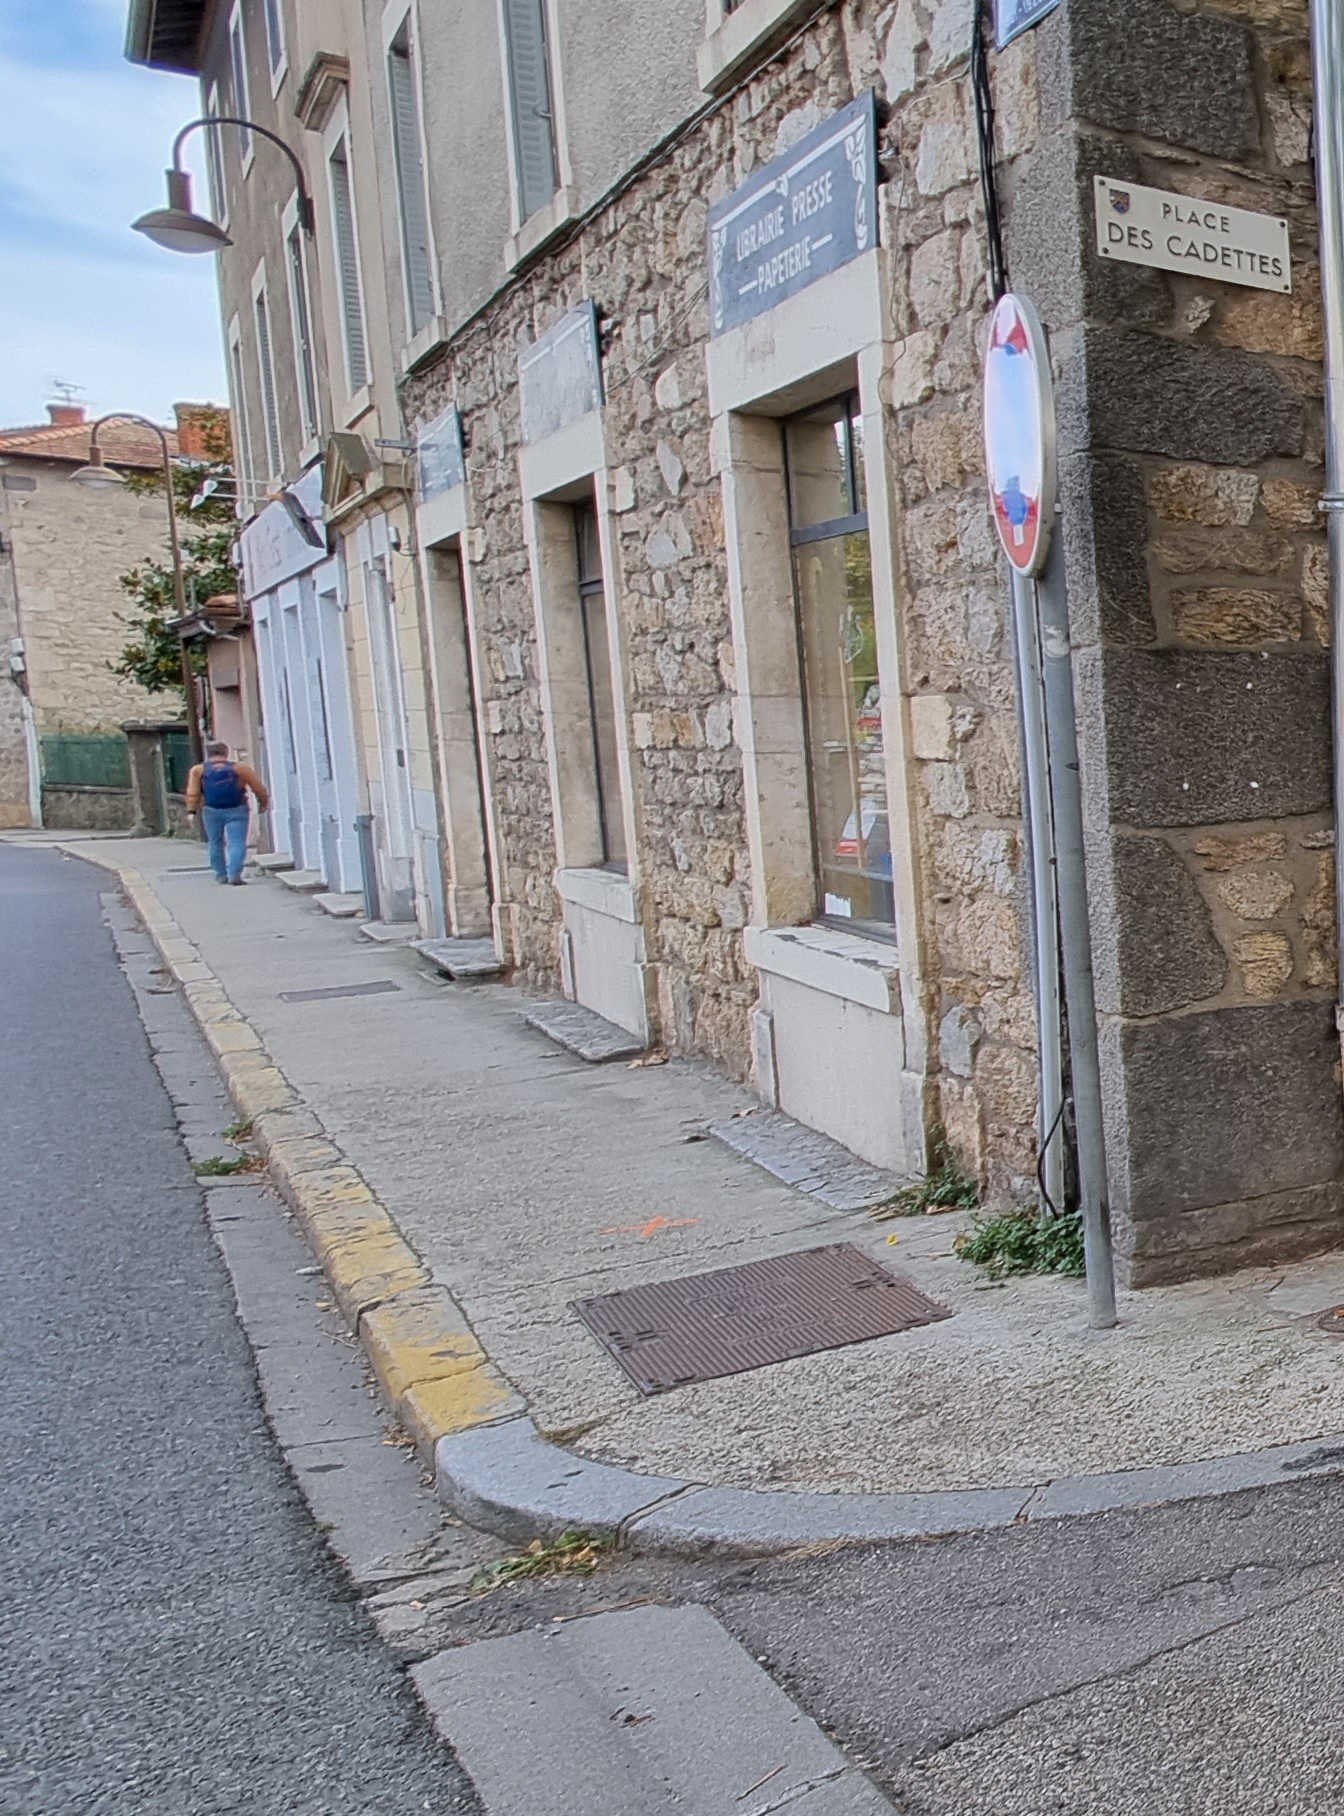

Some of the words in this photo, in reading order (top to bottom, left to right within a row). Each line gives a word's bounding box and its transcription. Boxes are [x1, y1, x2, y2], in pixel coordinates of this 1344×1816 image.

[736, 204, 785, 262] LIBRAIRIE
[792, 170, 832, 226] PRESSE
[1162, 202, 1230, 233] PLACE
[758, 235, 811, 295] PAPETERIE
[1107, 222, 1153, 250] DES
[1166, 235, 1282, 277] CADETTES
